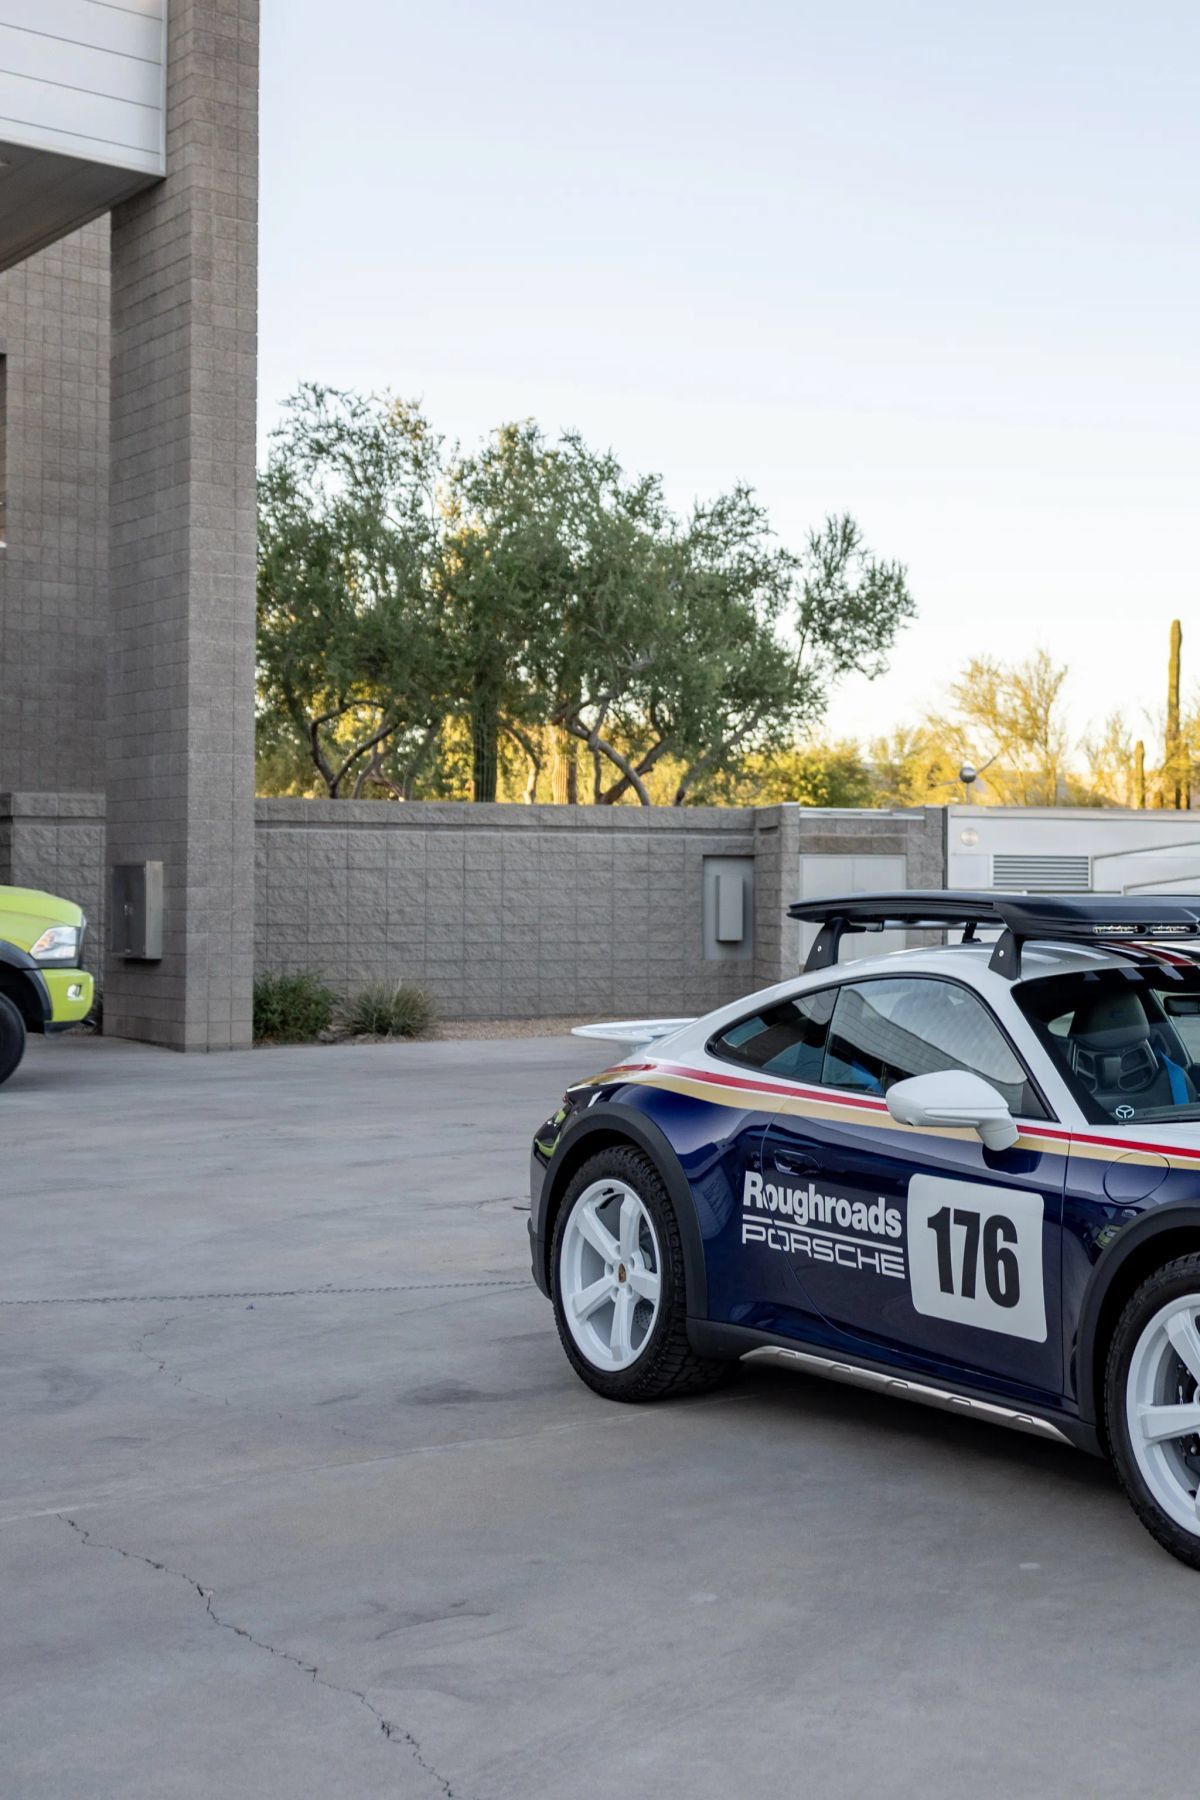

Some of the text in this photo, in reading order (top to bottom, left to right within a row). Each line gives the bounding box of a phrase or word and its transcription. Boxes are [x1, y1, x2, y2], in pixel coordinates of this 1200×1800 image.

[743, 1171, 902, 1238] Roughroads
[742, 1223, 905, 1279] PORSCHE
[927, 1206, 1020, 1308] 176
